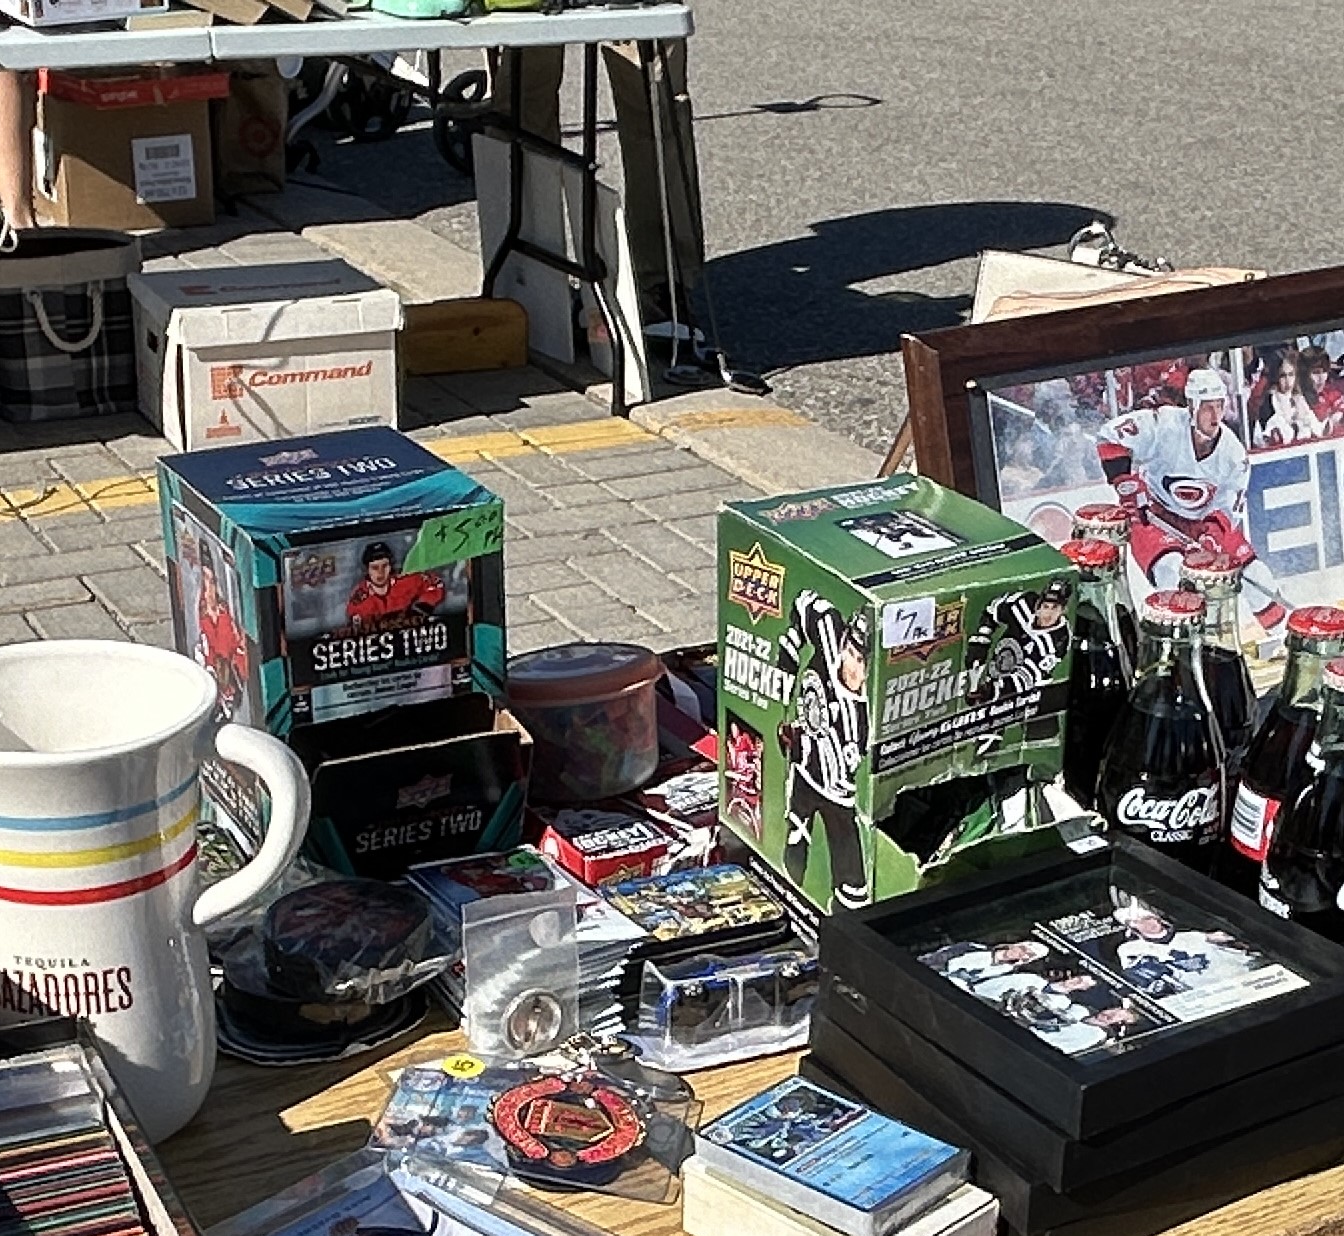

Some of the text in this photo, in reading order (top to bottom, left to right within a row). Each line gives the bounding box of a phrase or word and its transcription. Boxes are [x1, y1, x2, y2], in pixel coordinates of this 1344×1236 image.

[248, 361, 374, 388] Command
[226, 466, 332, 492] SERIES
[336, 455, 398, 478] TWO
[731, 578, 780, 605] DECK
[732, 560, 777, 587] UPPER
[311, 622, 449, 672] SERIES TWO
[724, 624, 773, 661] 2021-22
[723, 647, 795, 706] HOCKEY
[882, 660, 987, 726] HOCKEY
[886, 657, 953, 695] 2021-22
[940, 707, 987, 734] GUNS
[355, 808, 483, 854] SERIES TWO
[1151, 828, 1193, 843] CLASSIC
[13, 955, 91, 971] TEQUILA
